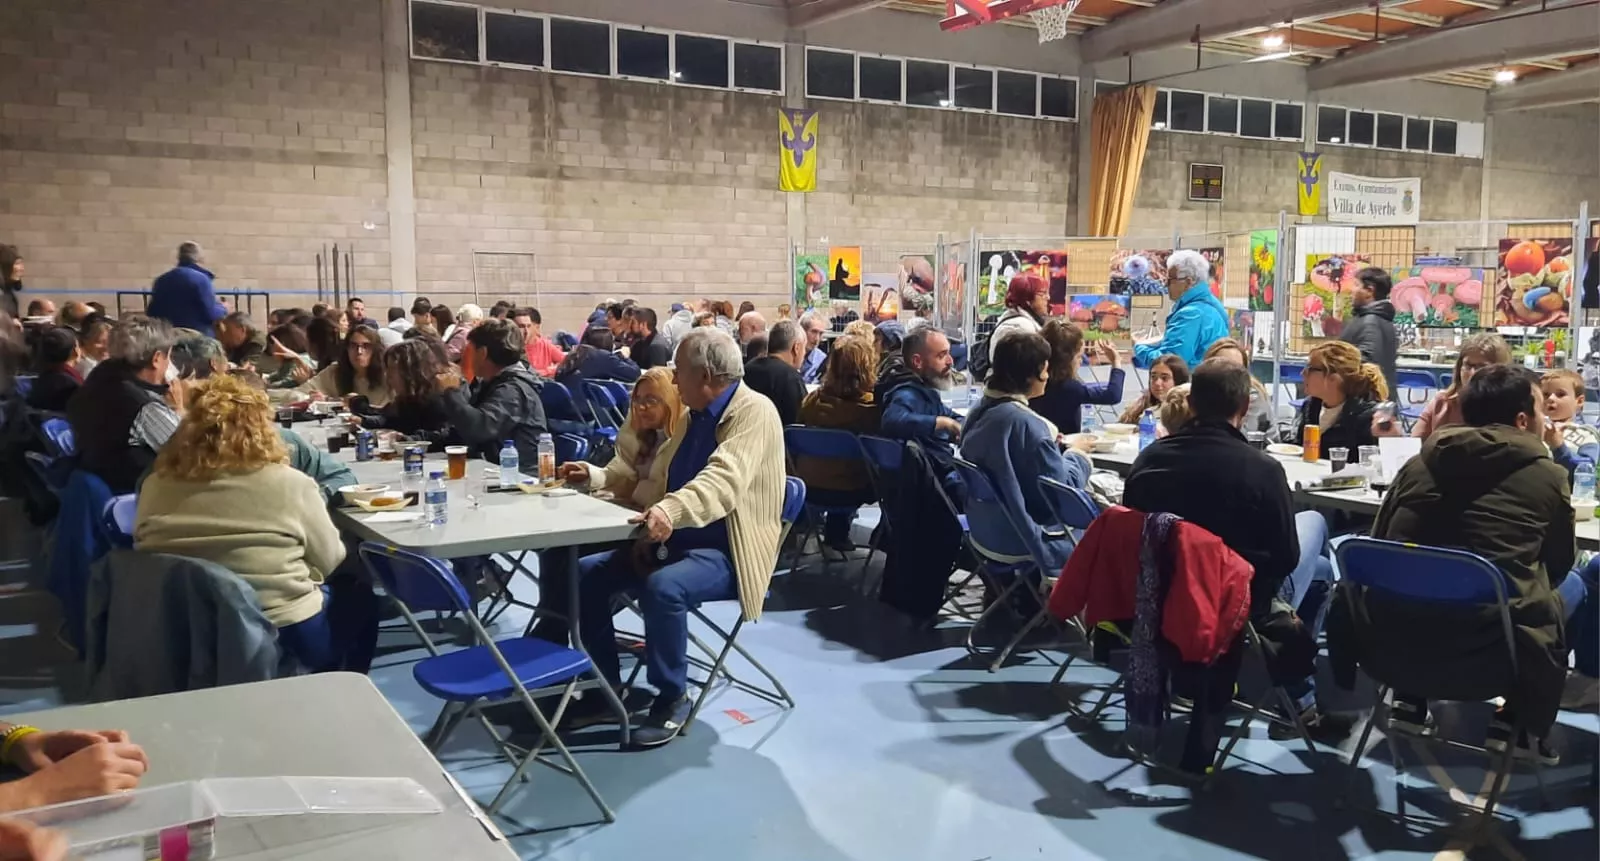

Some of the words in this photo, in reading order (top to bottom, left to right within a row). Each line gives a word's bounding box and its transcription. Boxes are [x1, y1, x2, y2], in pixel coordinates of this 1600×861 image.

[1333, 196, 1353, 214] Villa
[1355, 200, 1366, 215] de
[1368, 201, 1397, 219] Ayerbe
